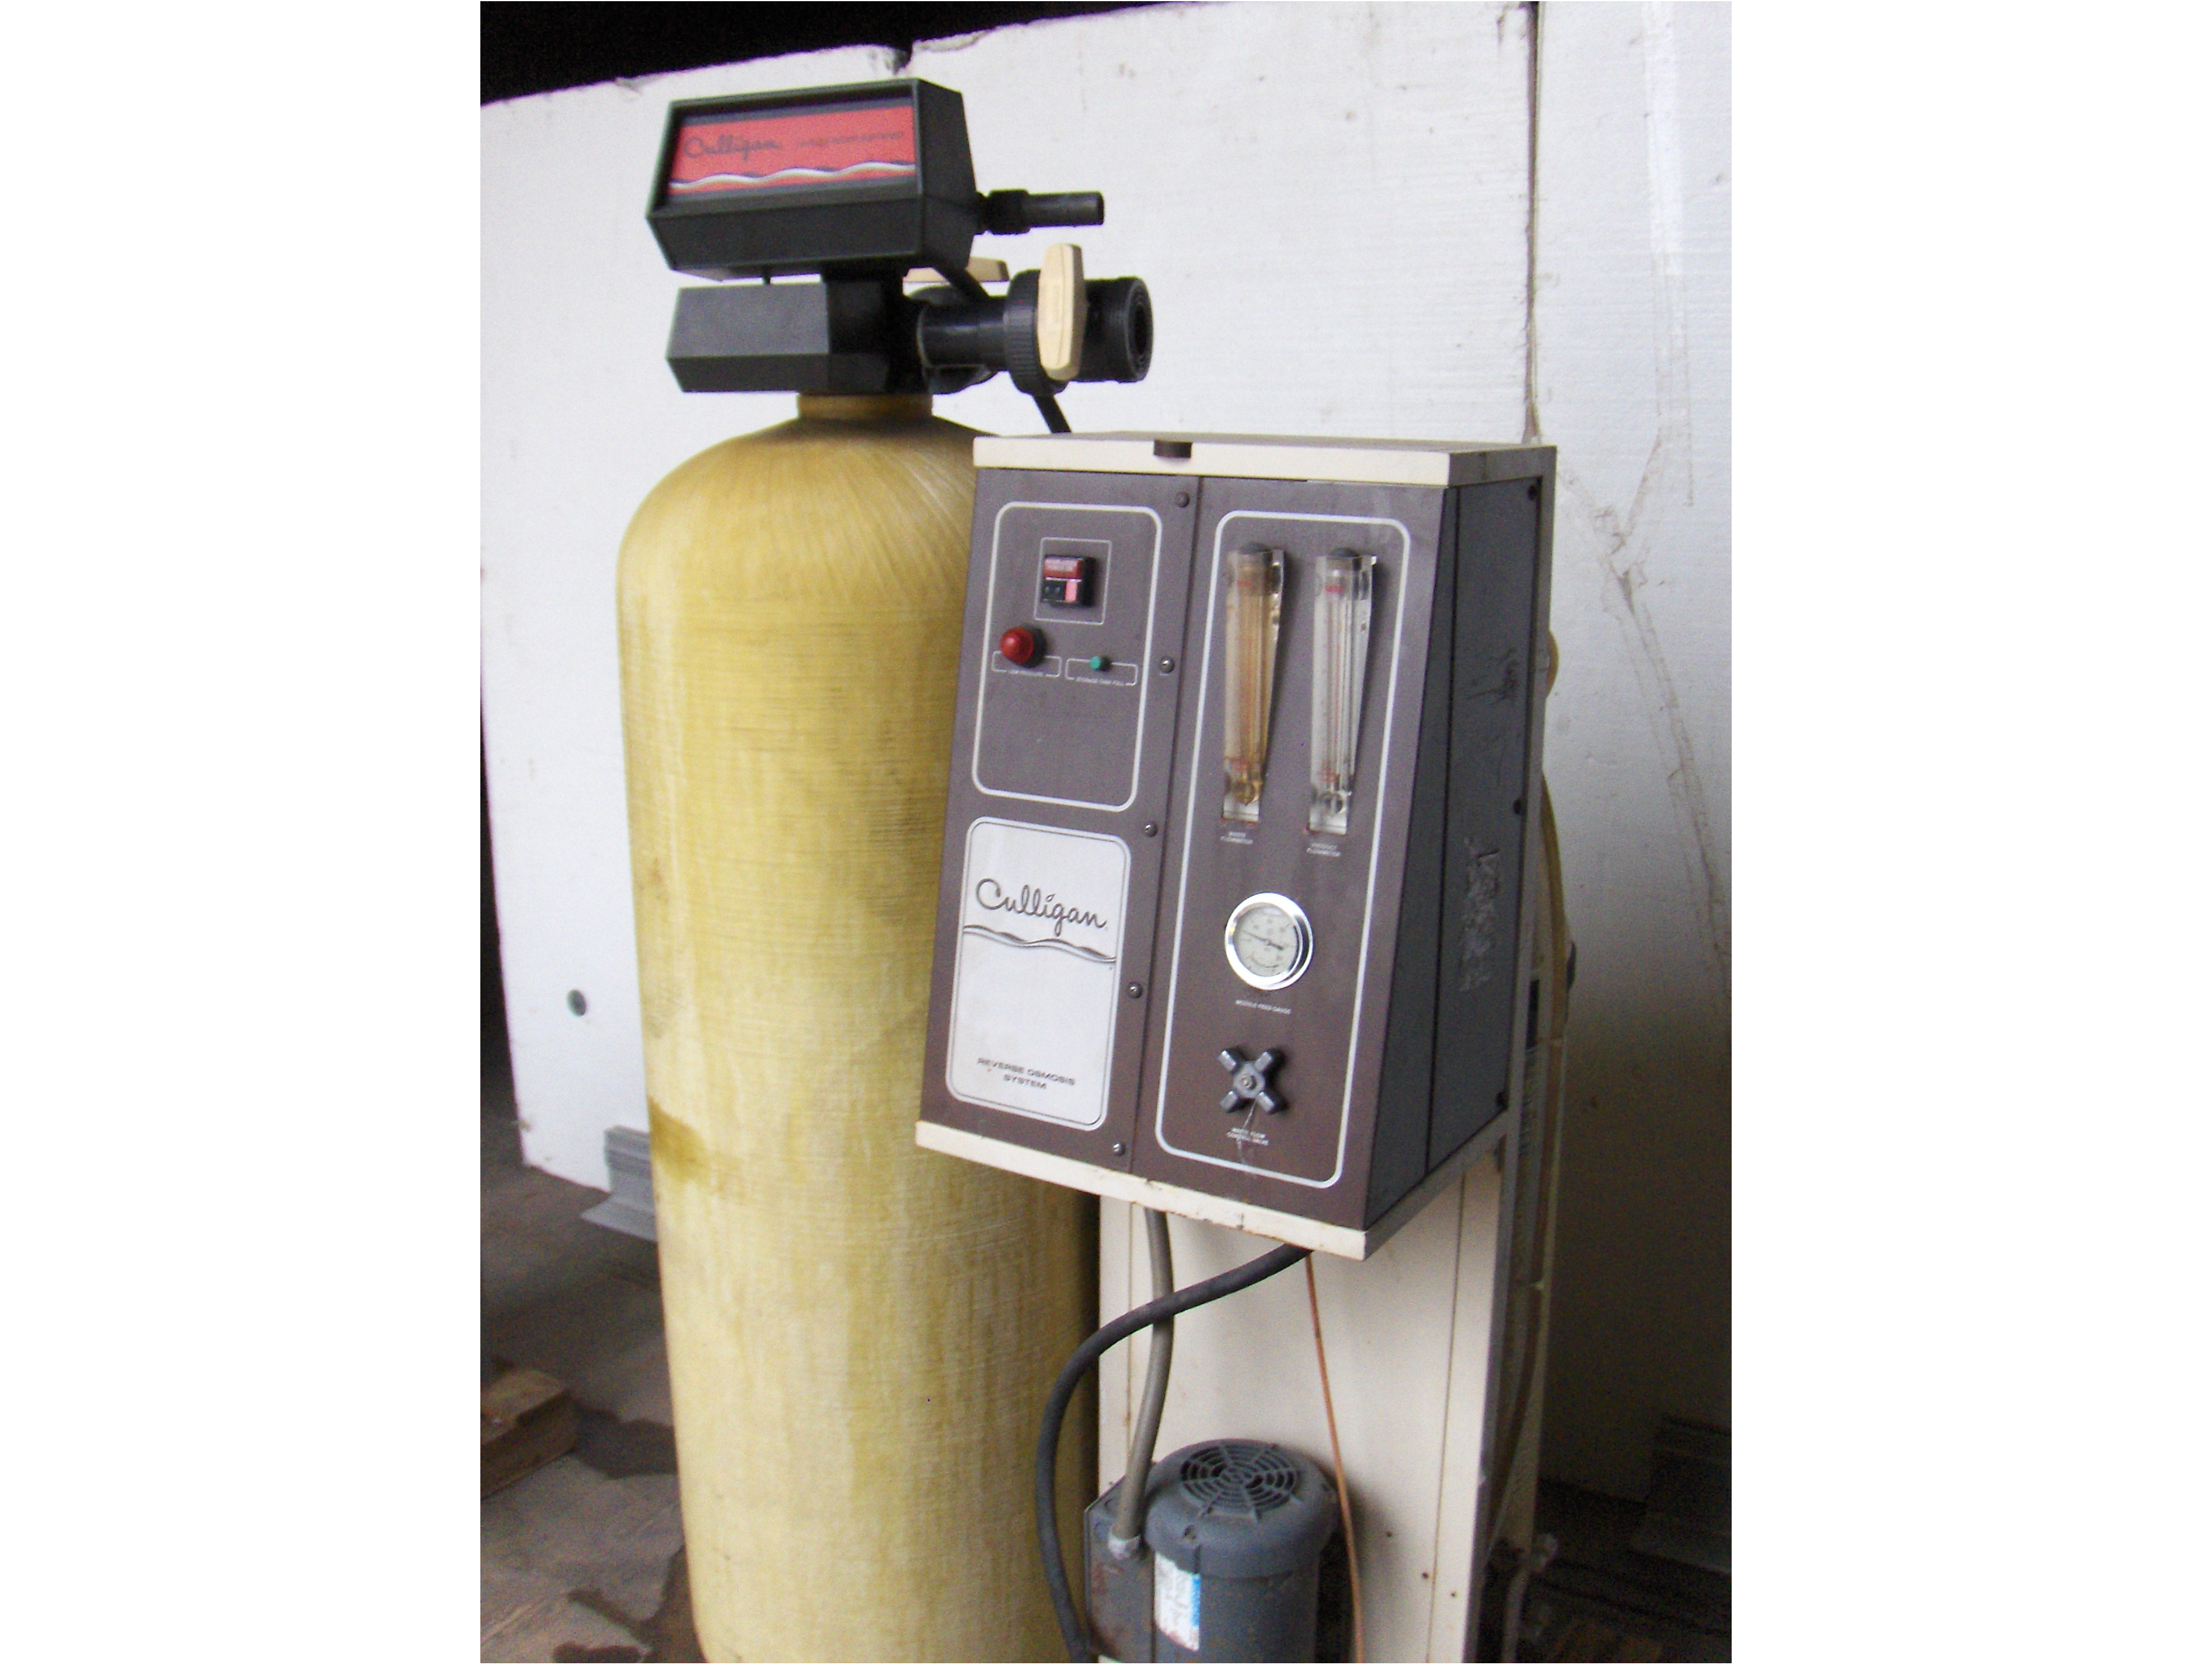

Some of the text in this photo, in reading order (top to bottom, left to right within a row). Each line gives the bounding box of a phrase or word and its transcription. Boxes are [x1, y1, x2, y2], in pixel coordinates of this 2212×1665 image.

[976, 878, 1107, 937] Culligan
[978, 1057, 1076, 1085] REVERSE OSMOSIS
[1004, 1074, 1047, 1089] SYSTEM
